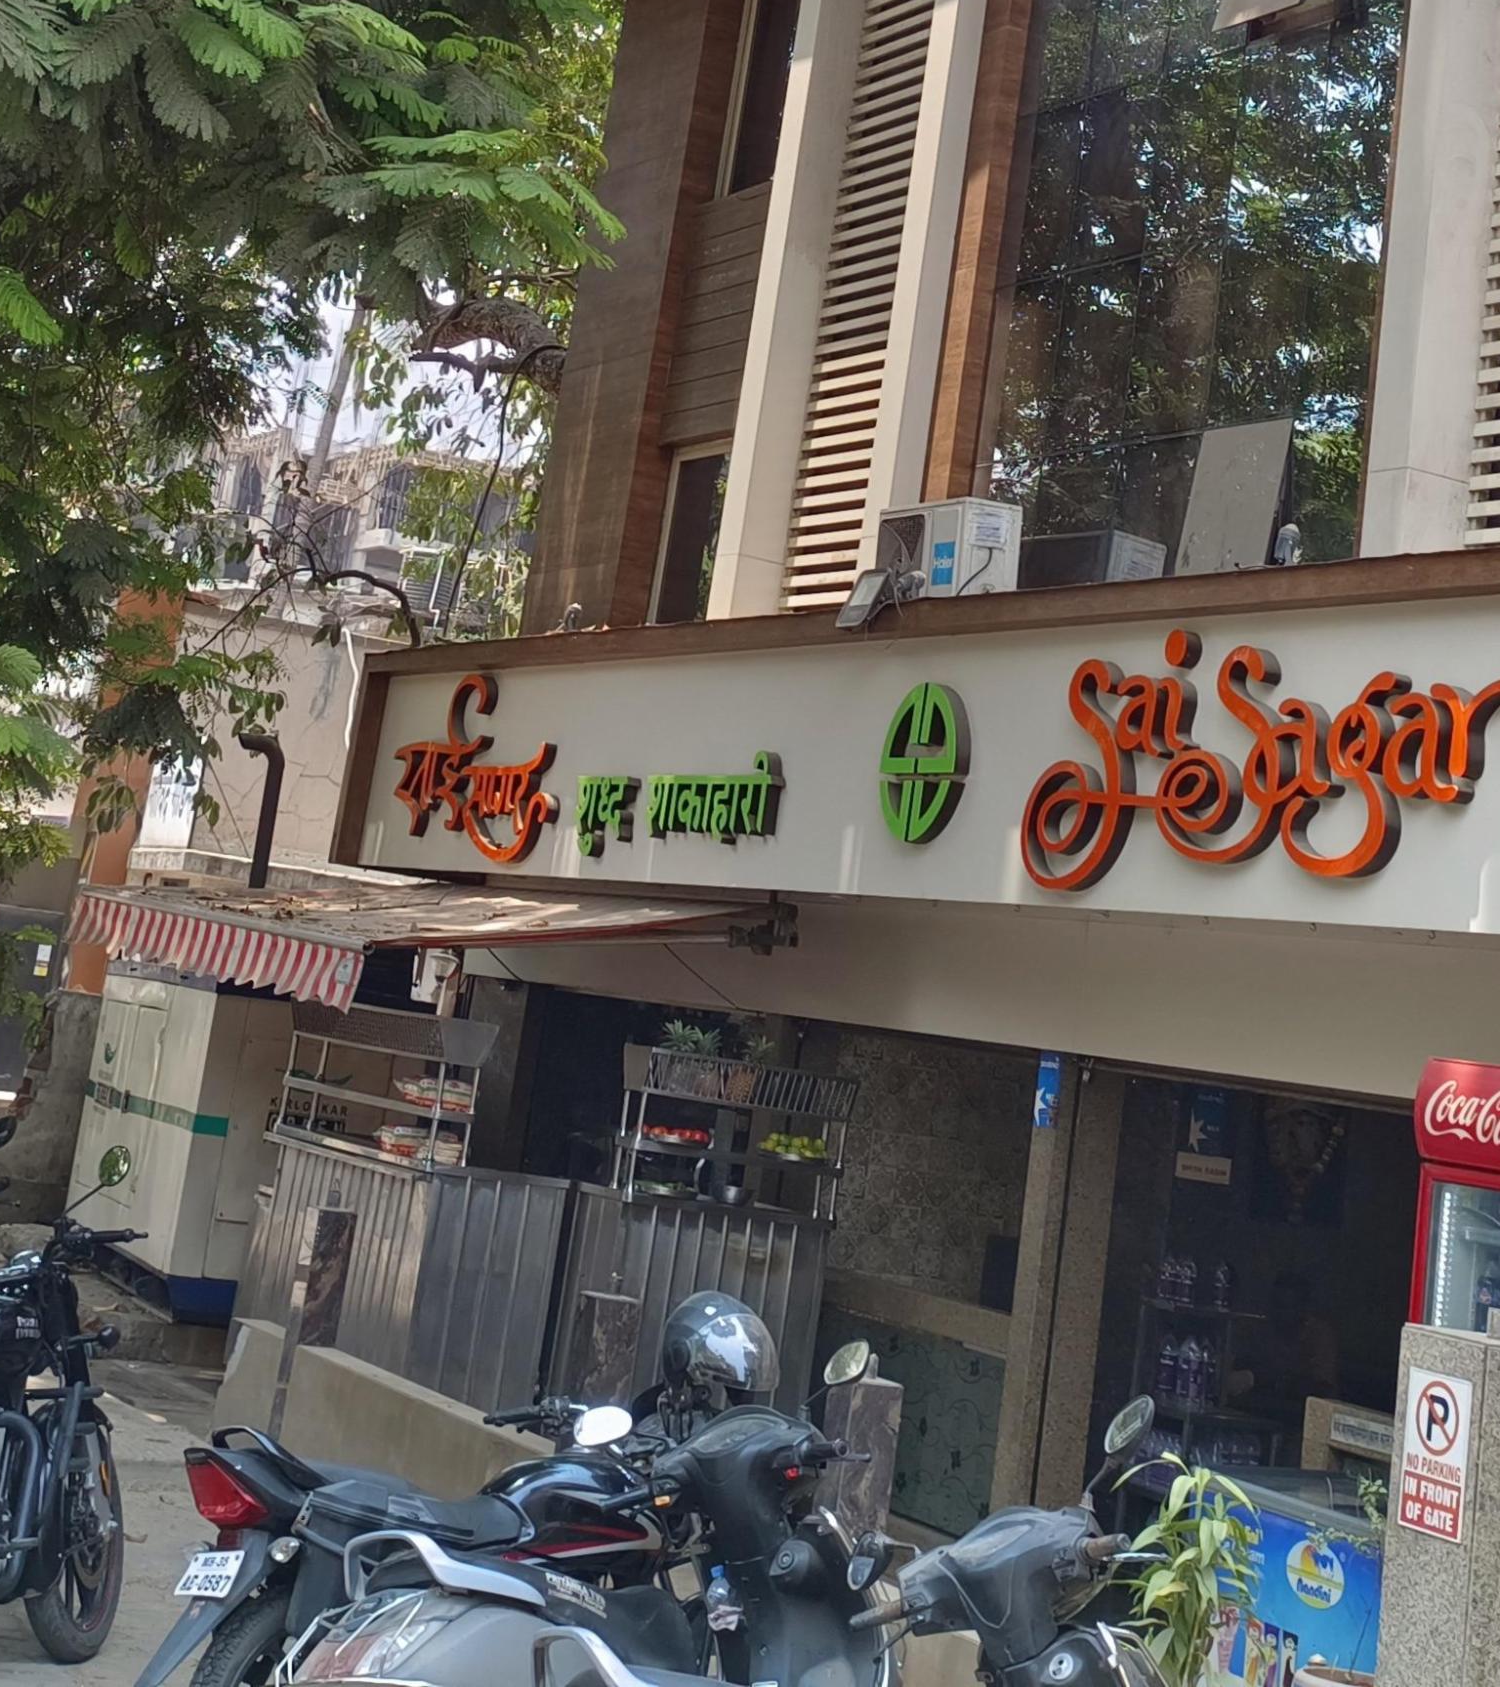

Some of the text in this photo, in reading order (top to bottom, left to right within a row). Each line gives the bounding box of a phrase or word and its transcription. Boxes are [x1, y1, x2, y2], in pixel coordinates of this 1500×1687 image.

[1020, 628, 1200, 892] Sai
[647, 750, 785, 844] शाकाहारी
[269, 1095, 348, 1117] KRLOKAR
[1406, 1452, 1462, 1484] NO PARKING
[1404, 1475, 1460, 1509] IN FRONT
[1405, 1500, 1454, 1533] OF GATE
